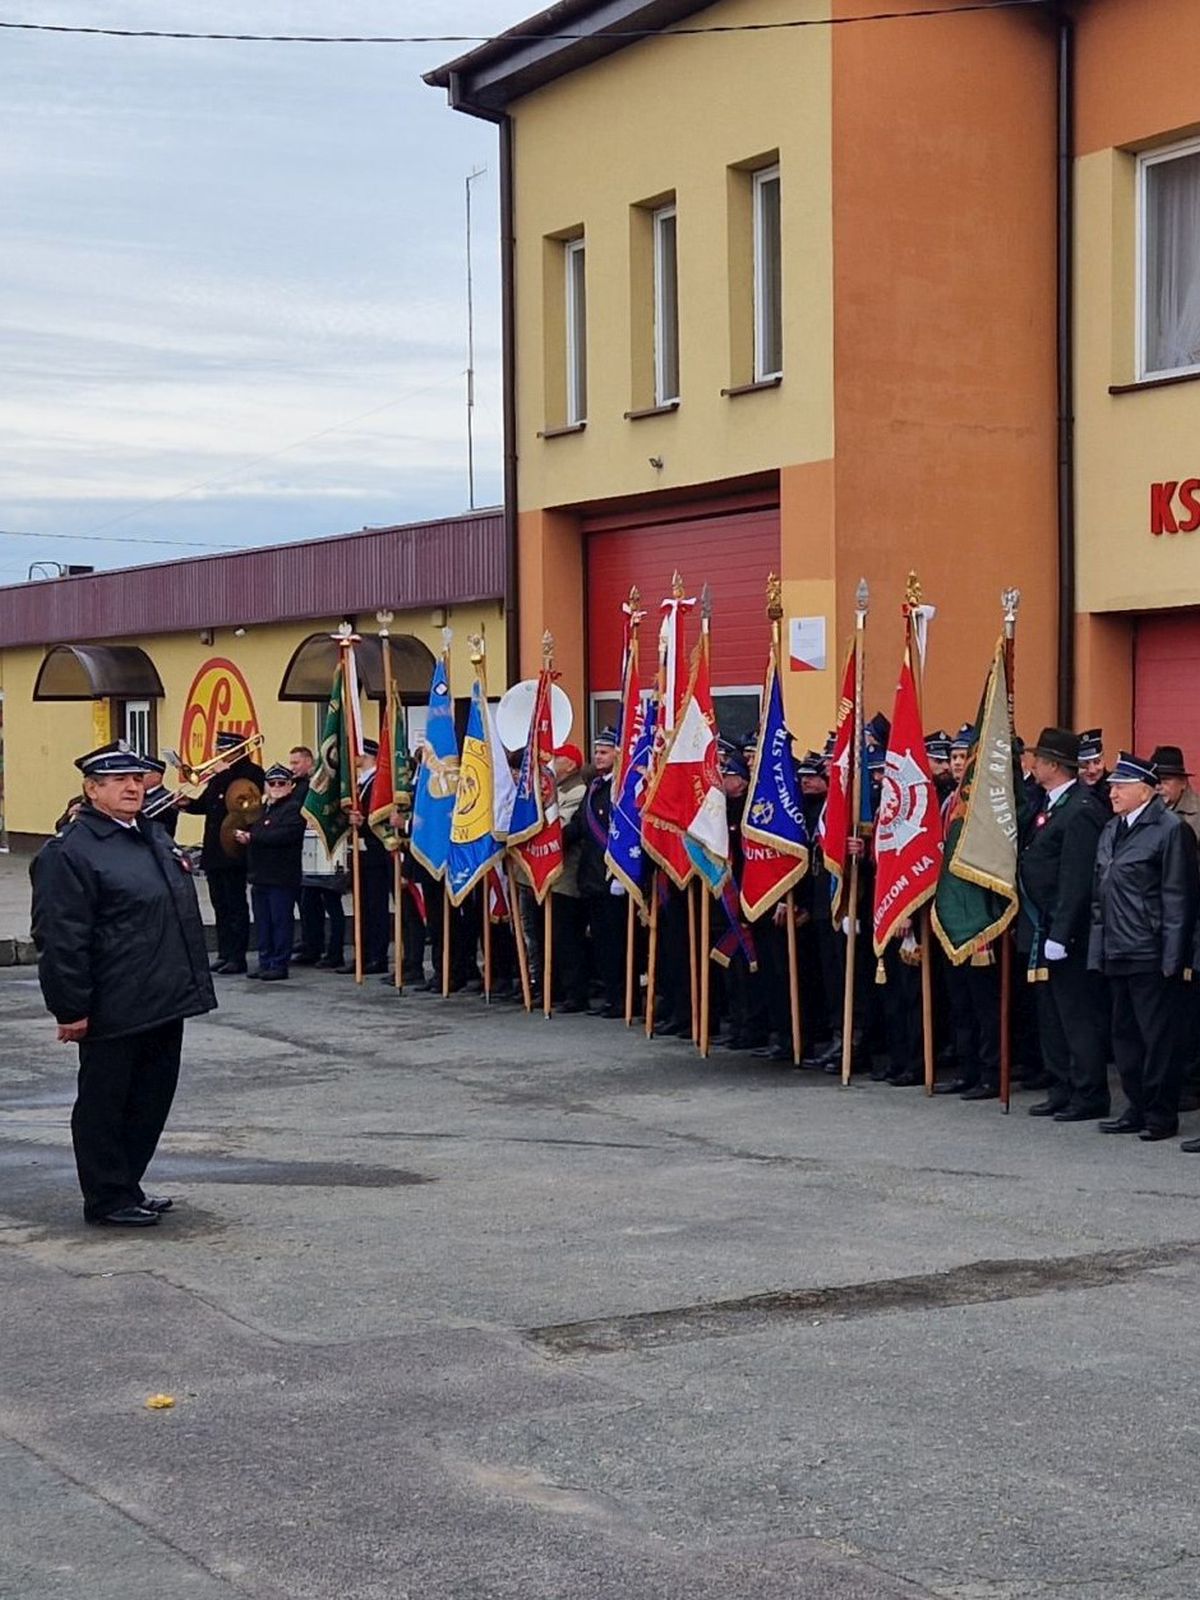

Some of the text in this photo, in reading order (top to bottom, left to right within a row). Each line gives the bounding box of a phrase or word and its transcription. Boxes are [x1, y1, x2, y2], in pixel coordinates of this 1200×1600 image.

[772, 721, 807, 828] OTNICZA STR
[989, 786, 1018, 850] IECKIE
[873, 855, 935, 929] UDZIOM NA
